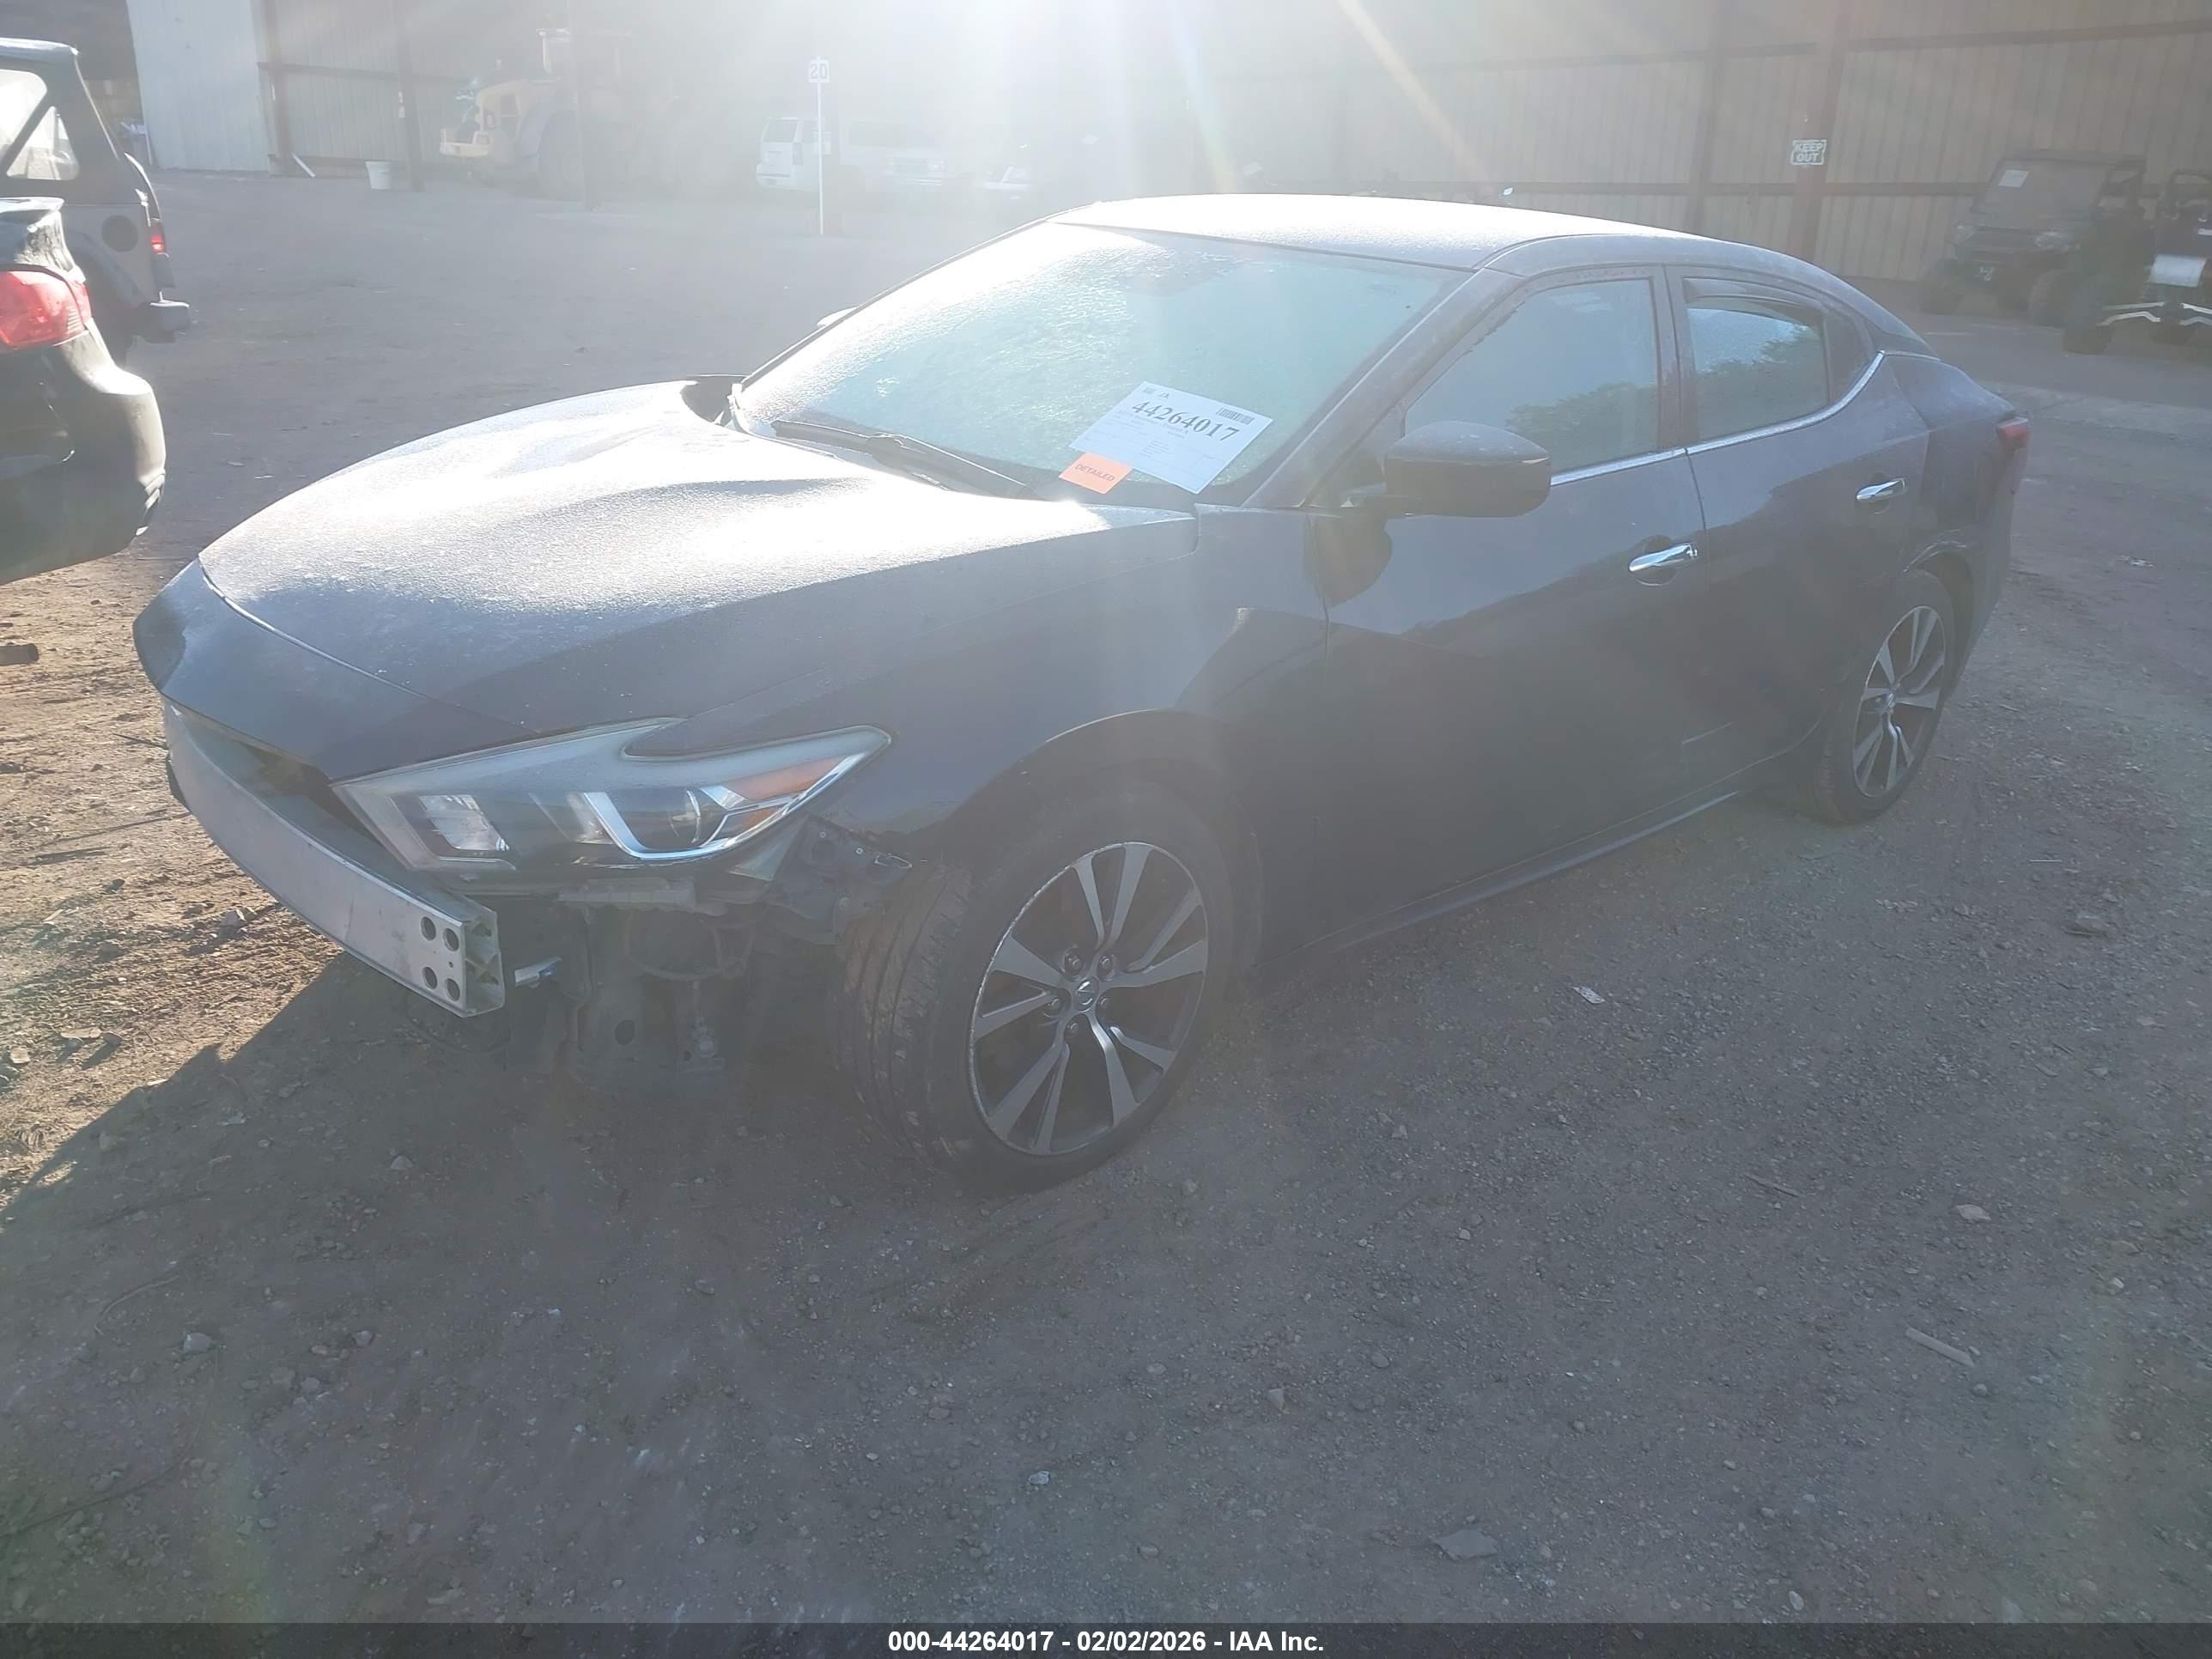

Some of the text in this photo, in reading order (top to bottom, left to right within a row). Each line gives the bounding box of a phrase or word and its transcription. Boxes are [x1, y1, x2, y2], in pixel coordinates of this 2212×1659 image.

[810, 63, 828, 79] 20
[1796, 153, 1819, 162] OUT
[1131, 401, 1240, 441] 44264017
